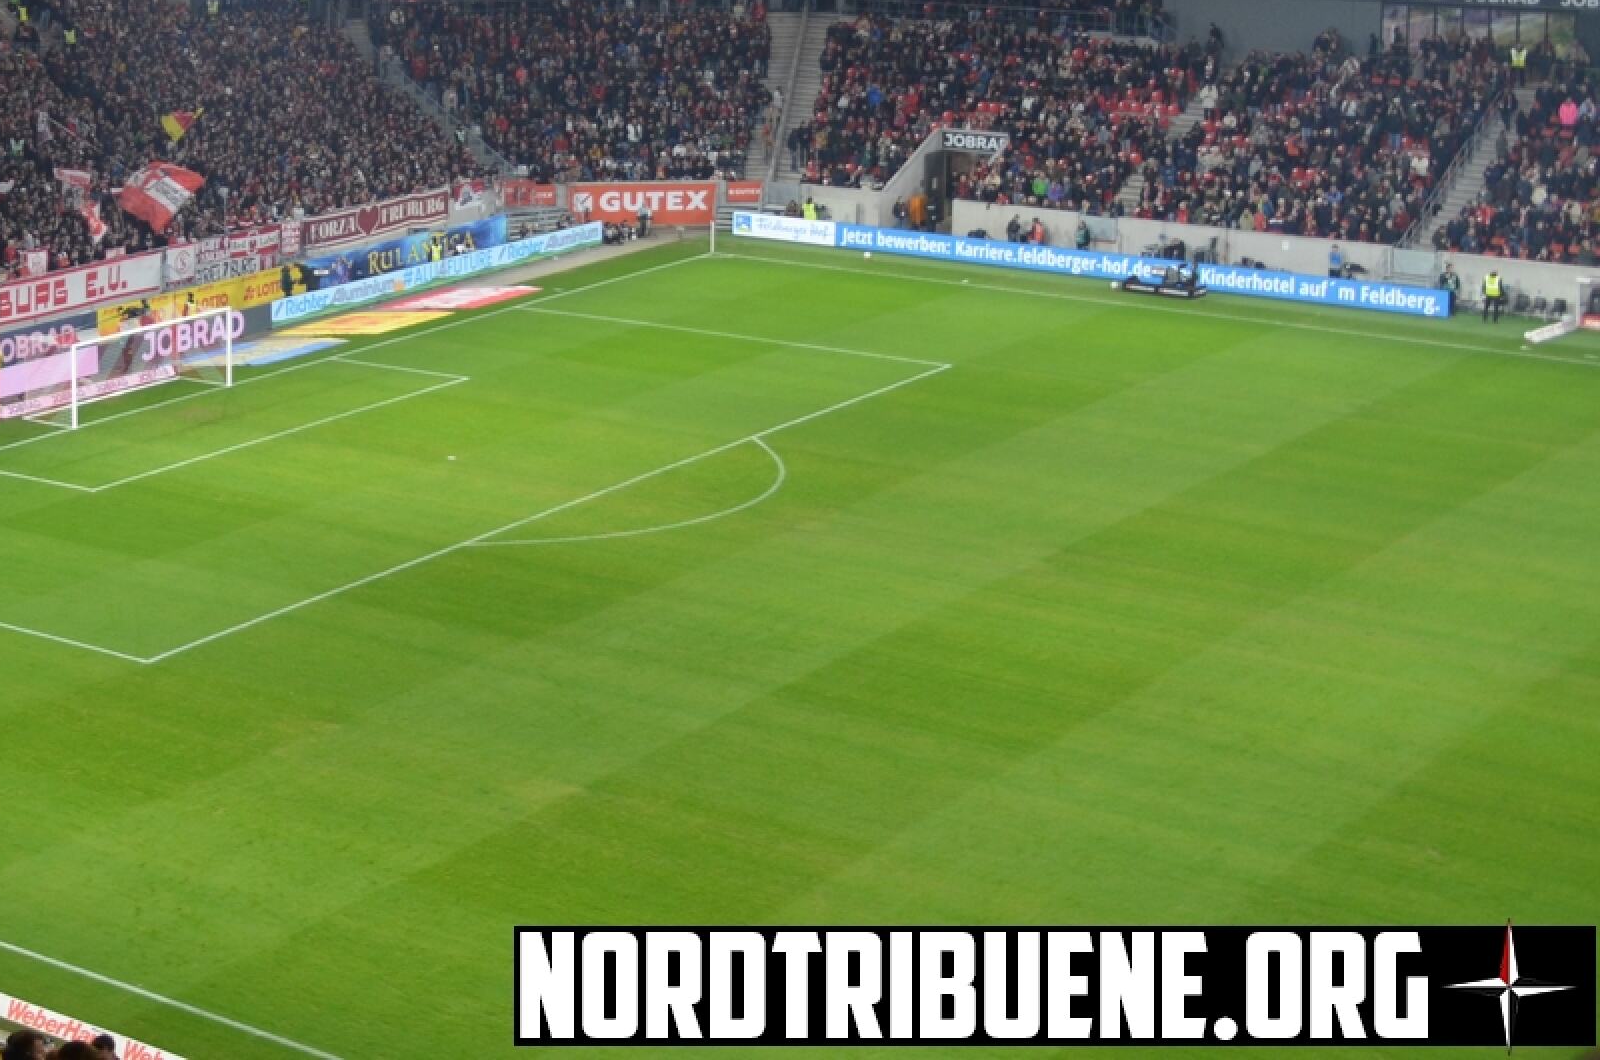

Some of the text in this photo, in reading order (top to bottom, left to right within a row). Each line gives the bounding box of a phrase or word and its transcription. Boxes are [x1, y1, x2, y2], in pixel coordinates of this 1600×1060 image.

[600, 190, 708, 212] GUTEX
[842, 227, 873, 247] Jetzt
[878, 231, 952, 255] bewerben:
[1200, 268, 1295, 294] Kinderhotel
[1360, 285, 1441, 315] Feldberg.
[142, 311, 245, 361] JOBRAD
[7, 998, 99, 1043] WeberHa
